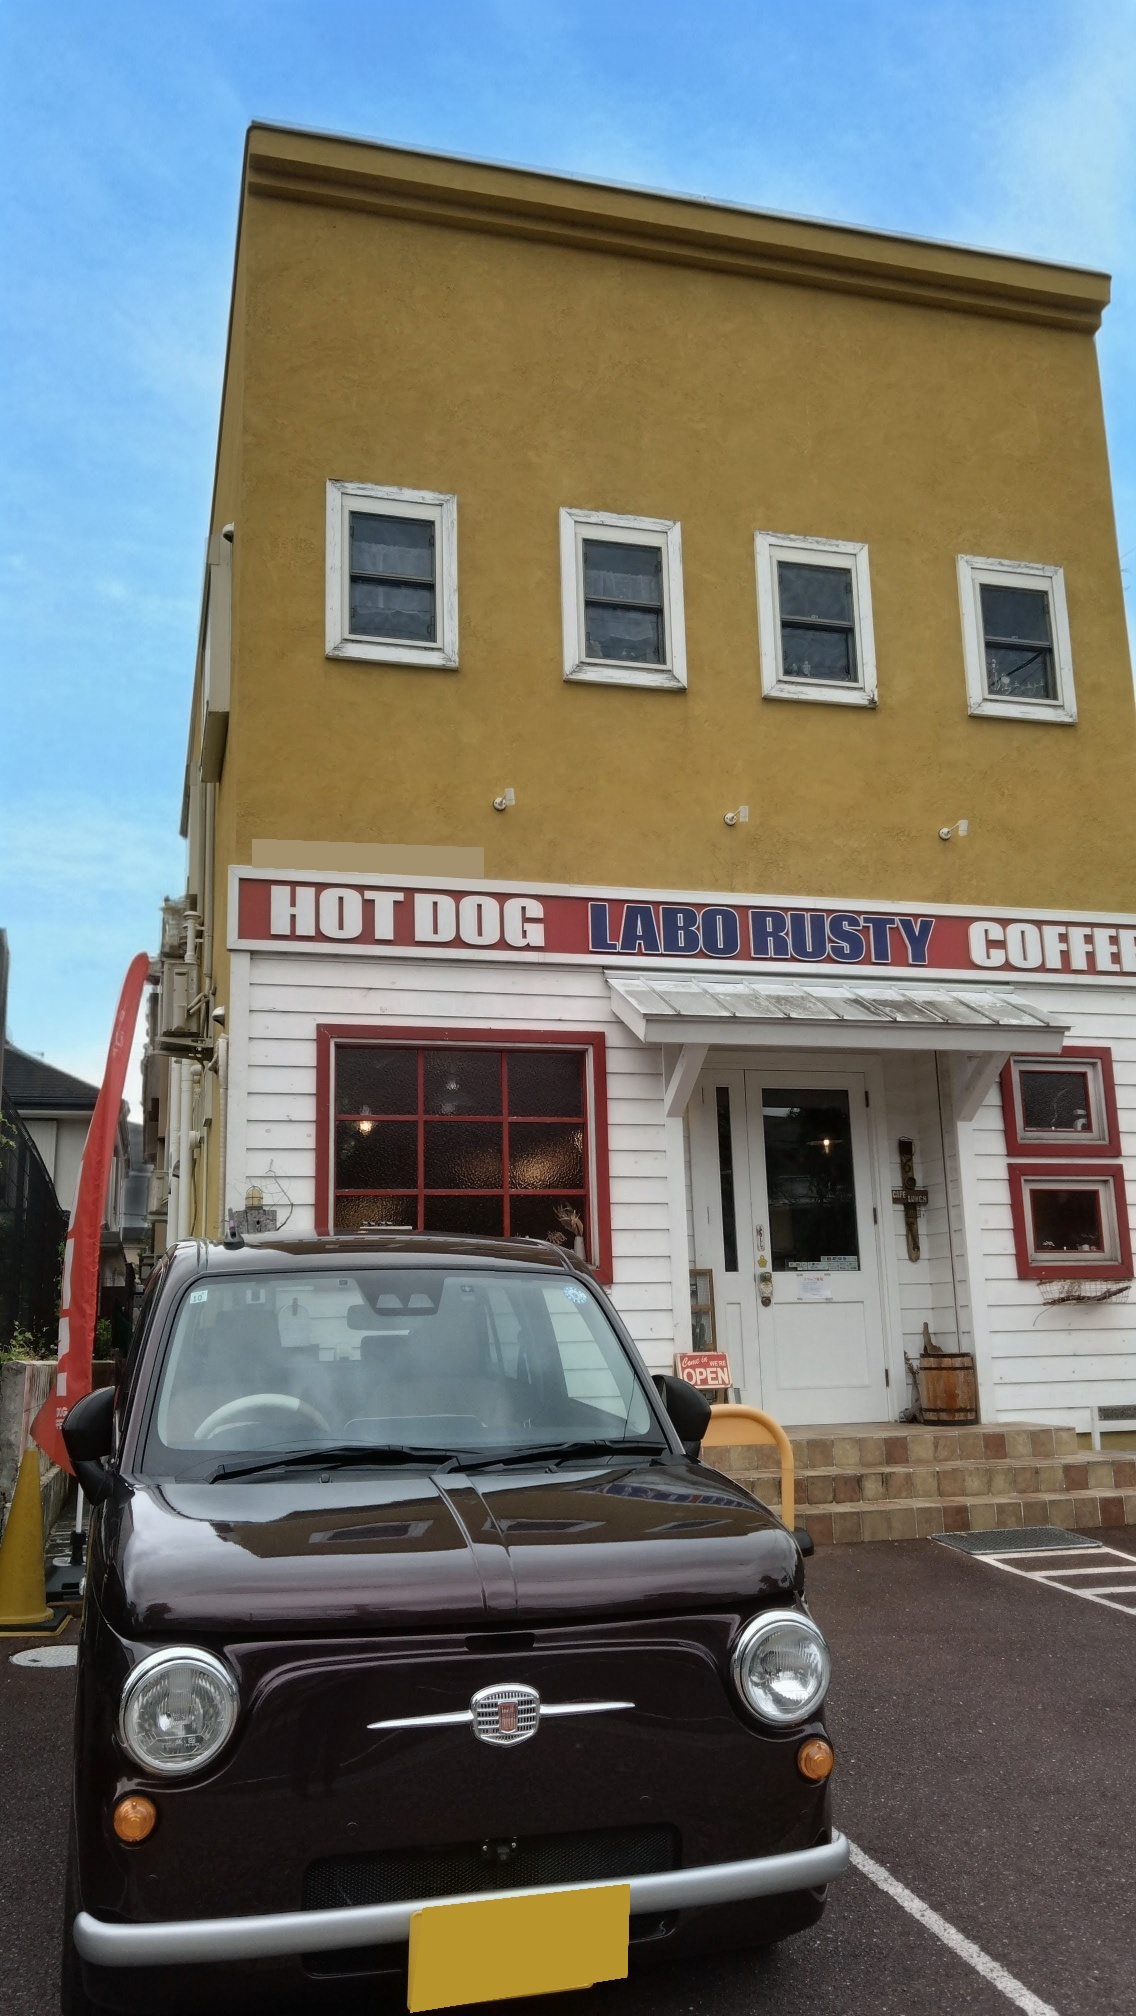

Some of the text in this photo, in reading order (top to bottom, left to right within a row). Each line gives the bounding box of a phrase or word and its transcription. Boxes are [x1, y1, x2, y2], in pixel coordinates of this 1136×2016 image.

[270, 885, 404, 941] HOT
[414, 892, 545, 948] DOG
[587, 901, 740, 958] LABO
[749, 909, 936, 966] RUSTY
[682, 1357, 700, 1367] Come
[683, 1367, 730, 1386] OPEN
